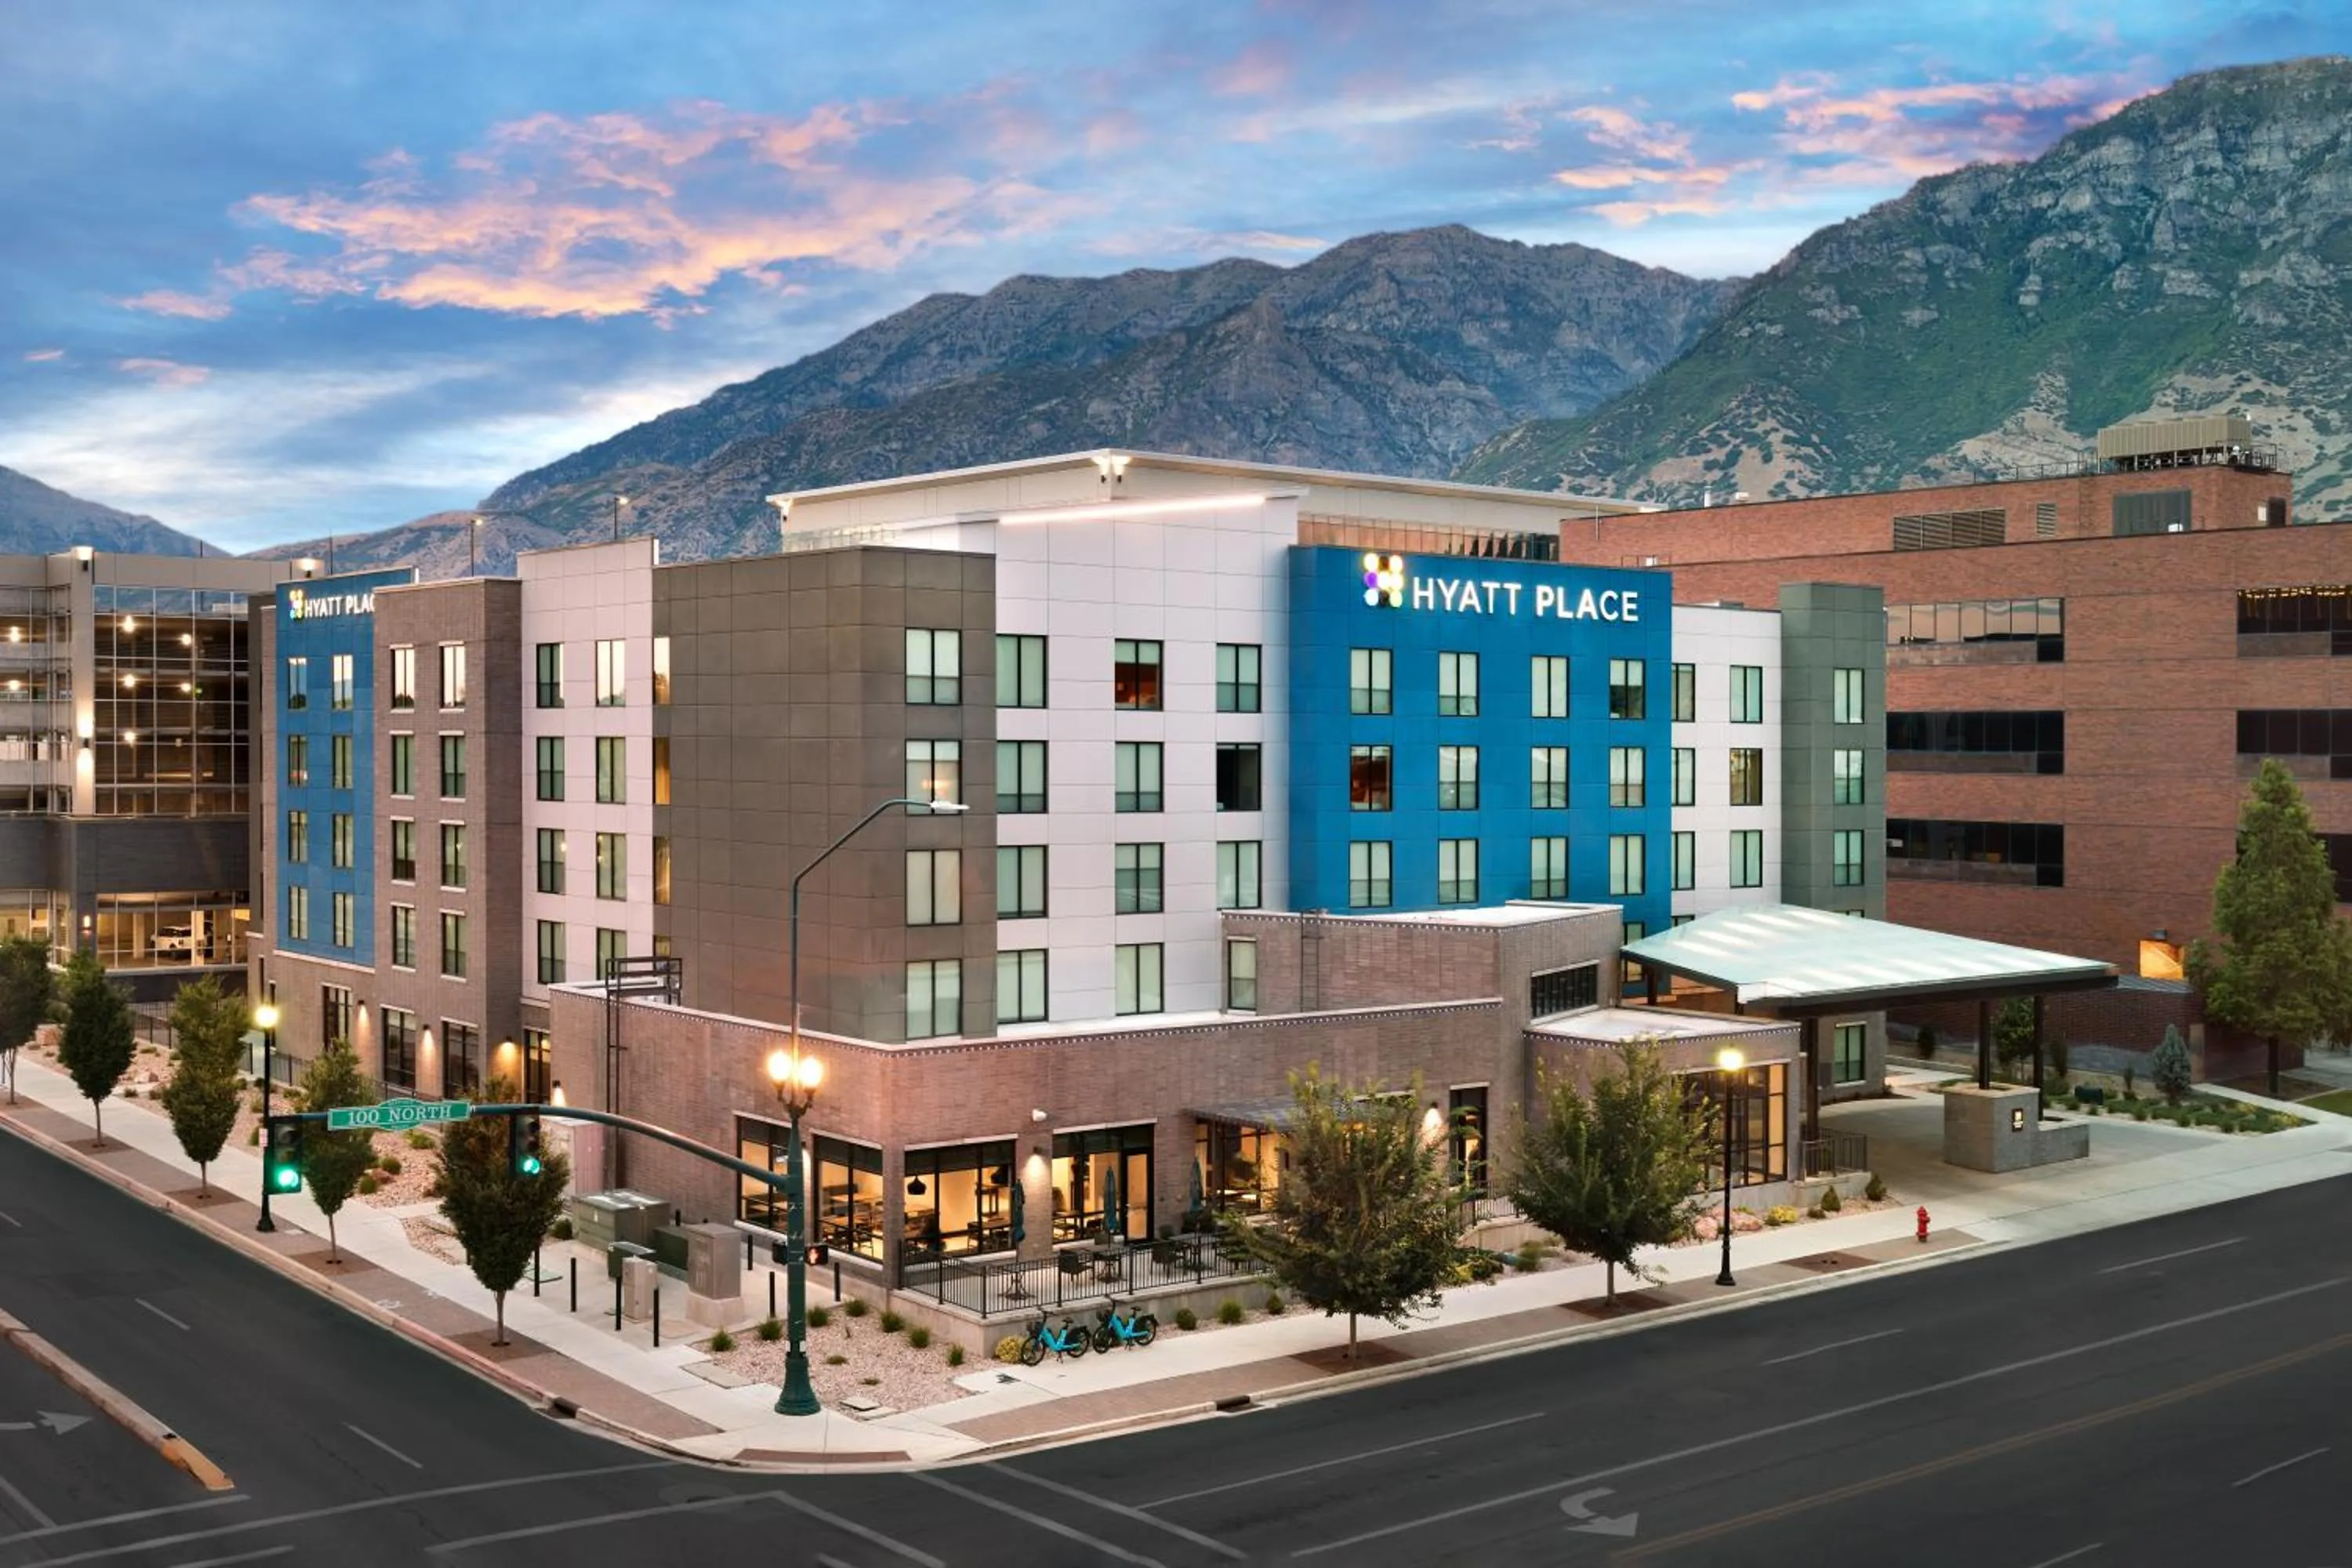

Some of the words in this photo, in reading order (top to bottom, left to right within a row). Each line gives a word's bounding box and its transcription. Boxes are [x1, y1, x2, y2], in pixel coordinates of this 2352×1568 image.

[304, 597, 343, 619] HYATT
[346, 593, 376, 615] PLAC
[1413, 577, 1522, 615] HYATT
[1535, 585, 1639, 622] PLACE
[348, 1109, 379, 1125] 100
[389, 1105, 452, 1122] NORTH
